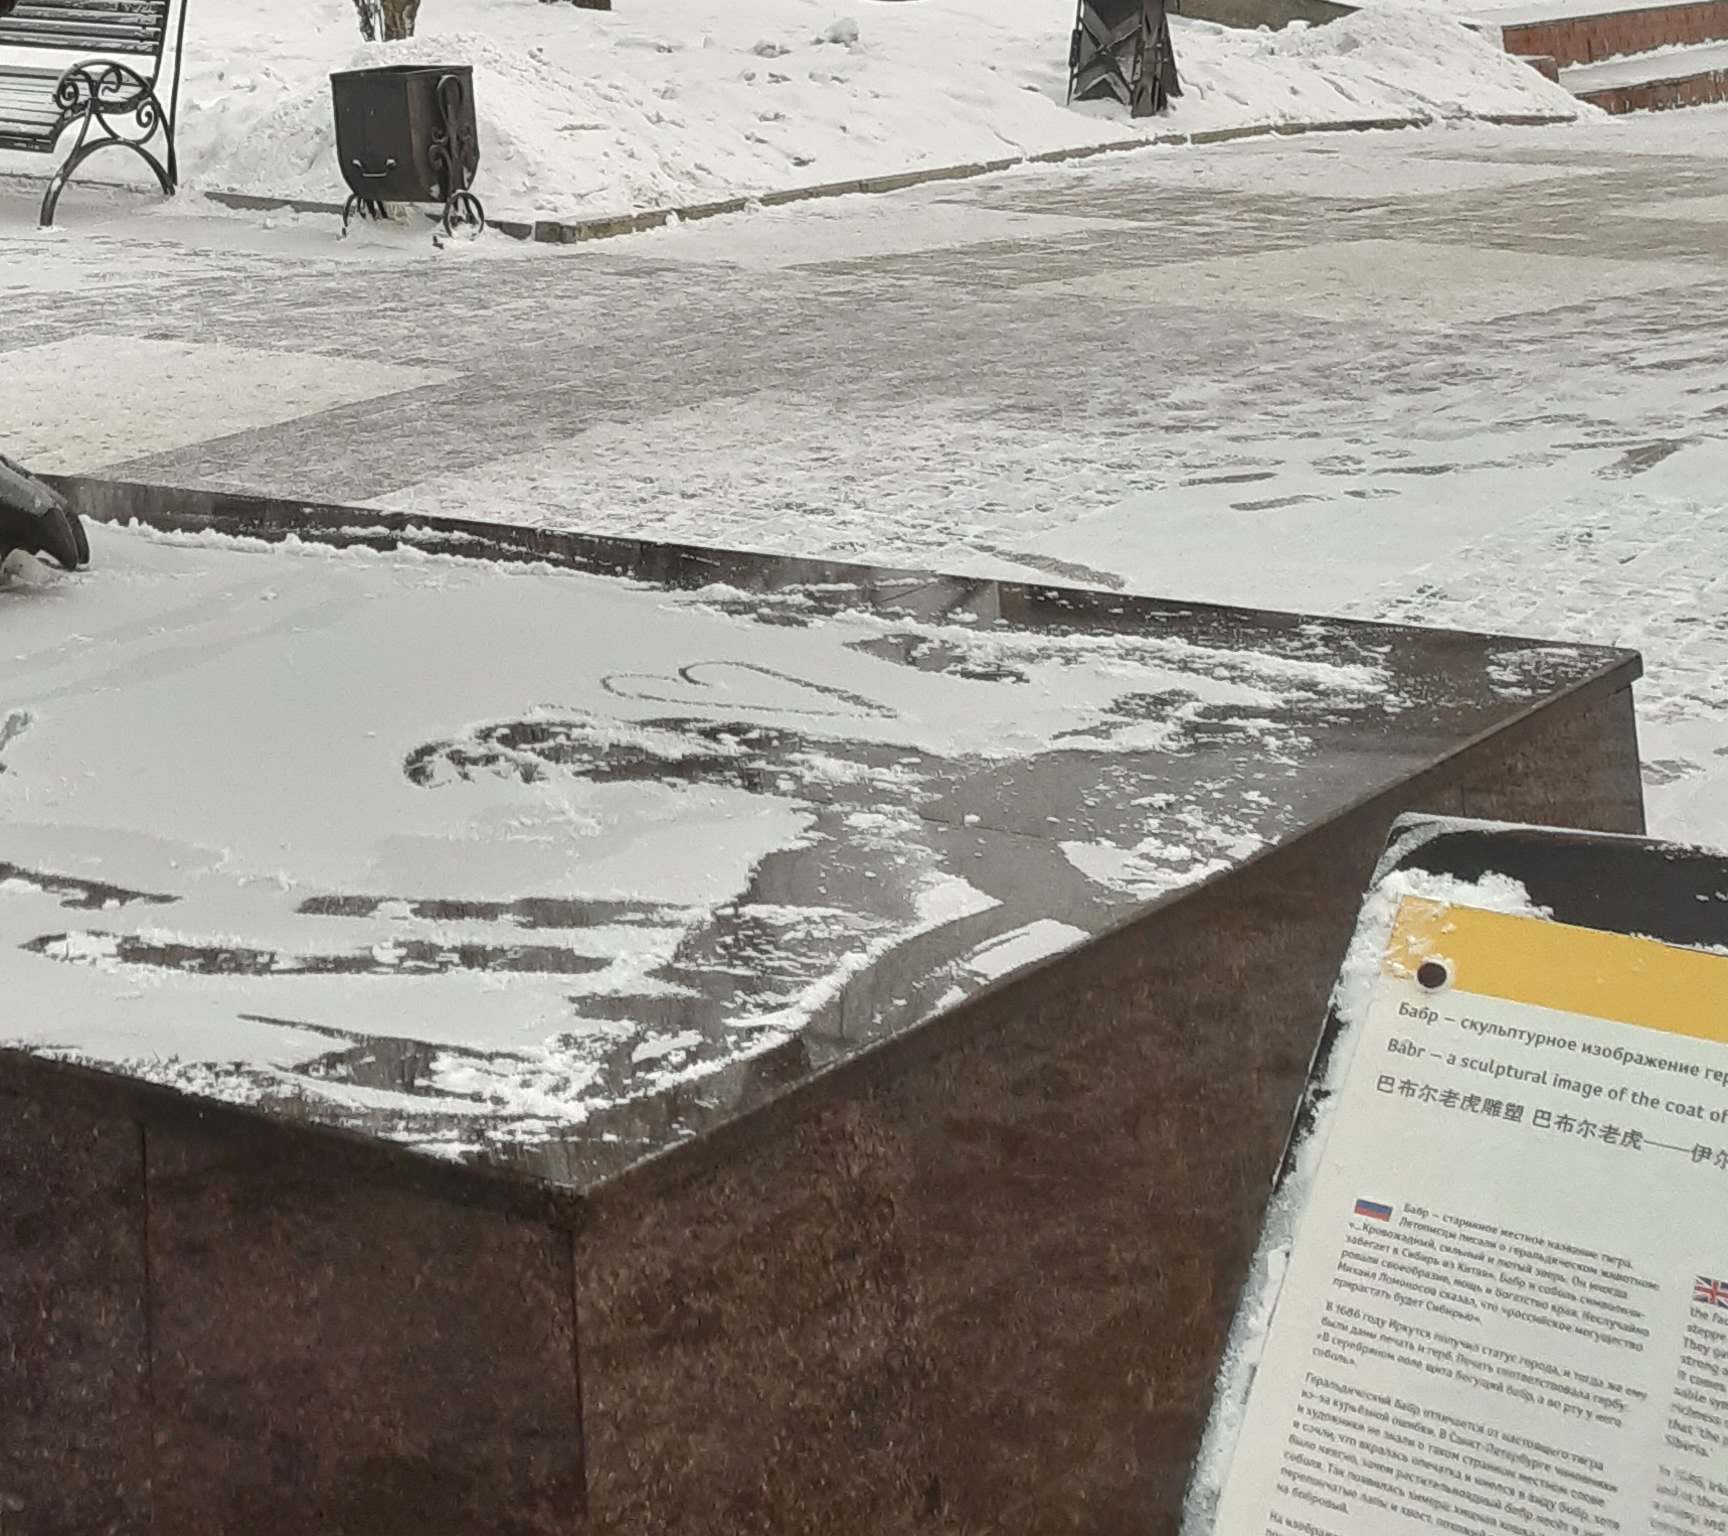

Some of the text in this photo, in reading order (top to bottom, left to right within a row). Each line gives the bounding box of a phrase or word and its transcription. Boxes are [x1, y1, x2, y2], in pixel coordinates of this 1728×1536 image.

[1398, 1001, 1438, 1025] Бабр
[1460, 1018, 1576, 1050] скульптурное
[1581, 1043, 1699, 1076] изображение
[1376, 1074, 1524, 1122] 巴布尔老虎雕塑
[1387, 1038, 1425, 1057] Babr
[1446, 1053, 1456, 1065] a
[1460, 1057, 1547, 1084] sculptural
[1552, 1073, 1603, 1097] image
[1607, 1087, 1628, 1101] of
[1631, 1091, 1660, 1109] the
[1665, 1101, 1704, 1119] coat
[1709, 1110, 1726, 1123] of
